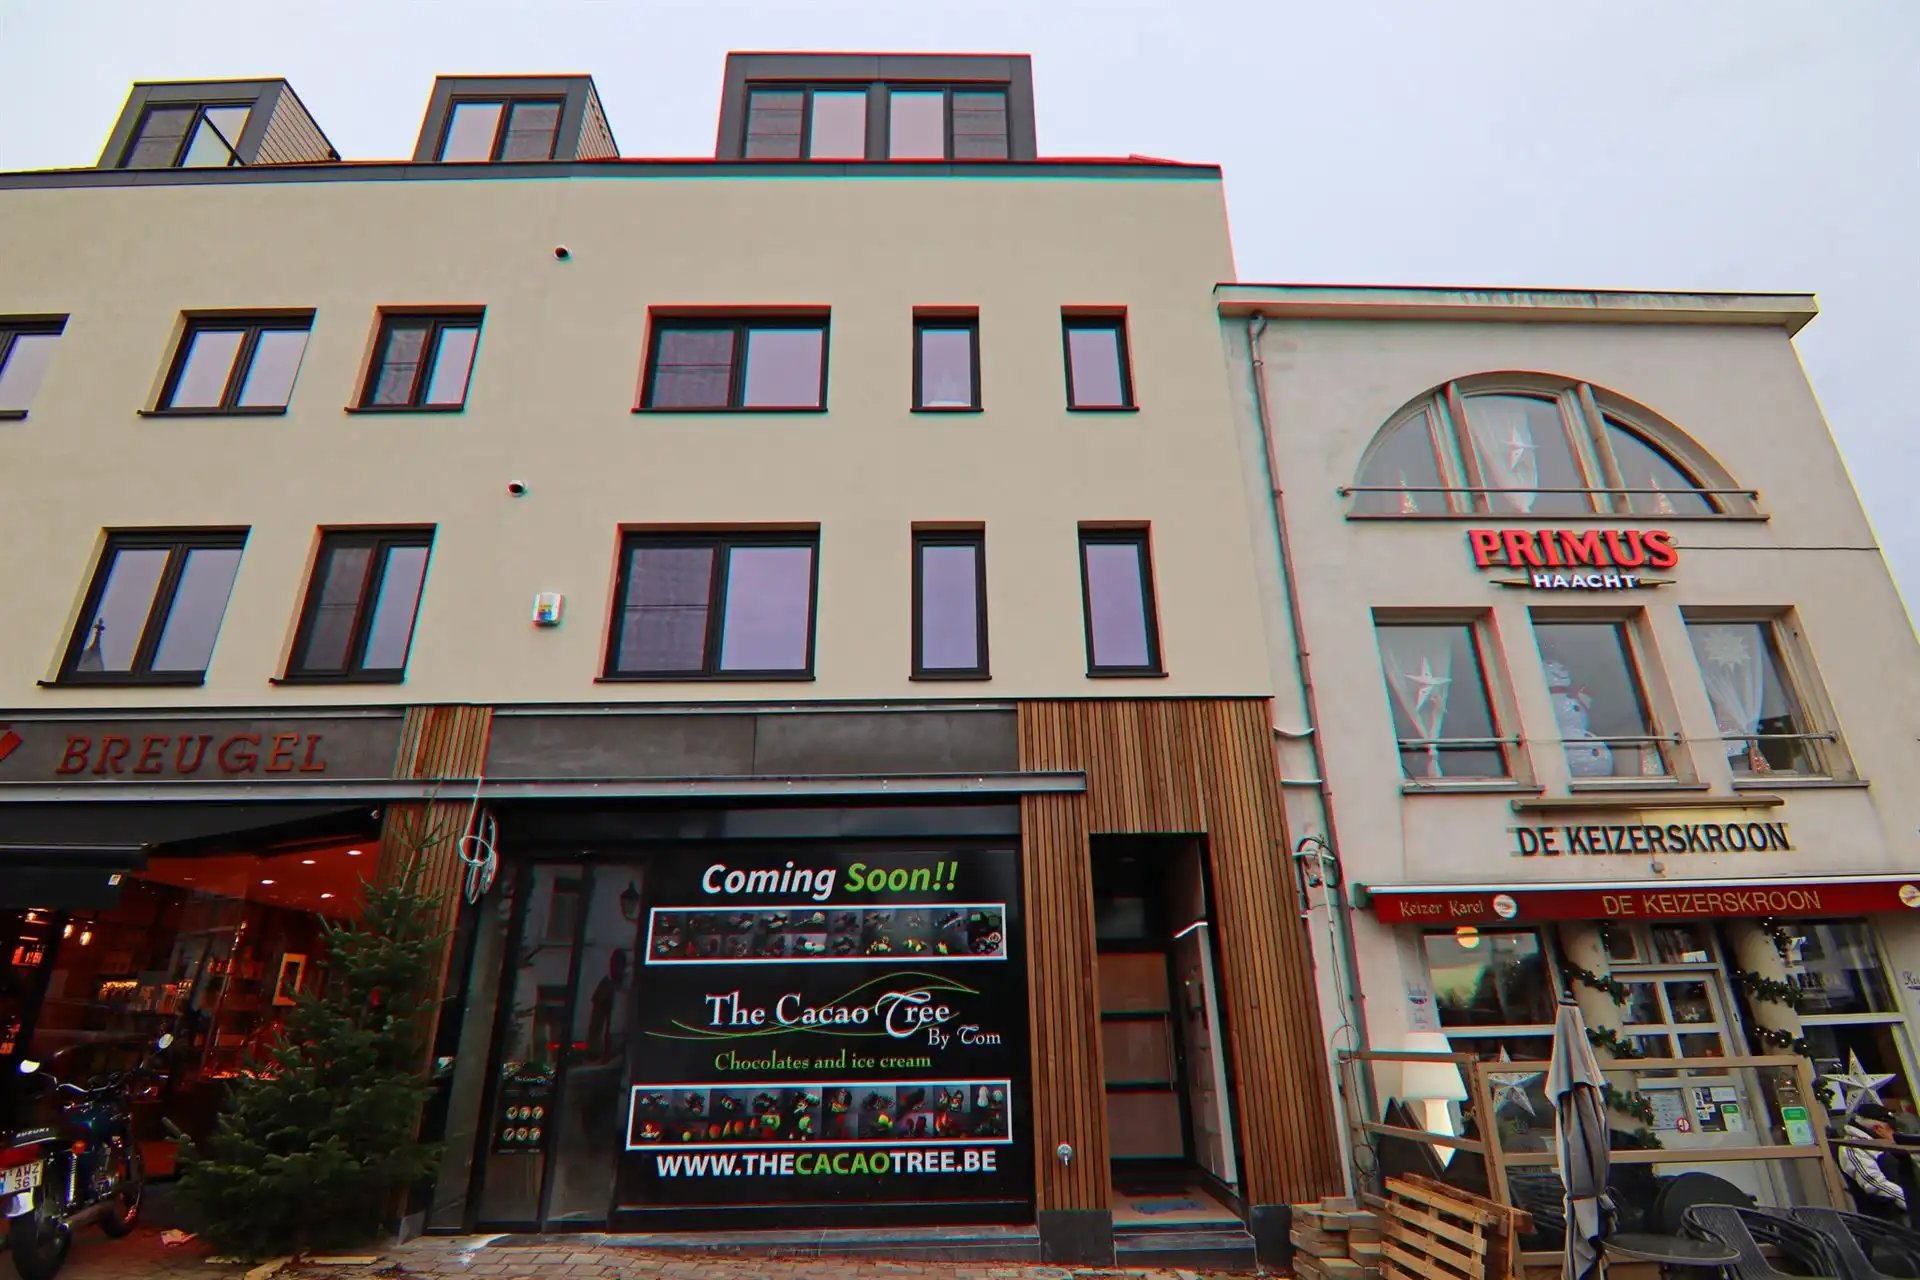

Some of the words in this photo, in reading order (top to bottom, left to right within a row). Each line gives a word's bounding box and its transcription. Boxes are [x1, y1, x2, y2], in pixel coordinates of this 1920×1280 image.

[1467, 529, 1679, 569] PRIMUS
[1533, 573, 1638, 589] HAACHT
[55, 733, 327, 774] BREUGEL
[1516, 826, 1561, 857] DE
[1566, 822, 1792, 855] KEIZERSKROON
[702, 861, 837, 901] Coming
[845, 861, 959, 893] Soon!!
[1400, 900, 1444, 917] Keizer
[1448, 899, 1485, 917] Karel
[1602, 894, 1636, 916] DE
[1643, 889, 1821, 914] KEIZERSKROON
[705, 991, 767, 1027] The
[775, 992, 870, 1027] Cacao
[874, 990, 951, 1039] Tree
[927, 1027, 951, 1050] By
[957, 1024, 1002, 1046] Tom
[714, 1050, 810, 1072] Chocolates
[814, 1049, 846, 1070] and
[852, 1052, 875, 1069] ice
[880, 1052, 932, 1069] cream
[656, 1149, 997, 1177] WWW.THECACAOTREE.BE
[14, 1175, 38, 1189] 361
